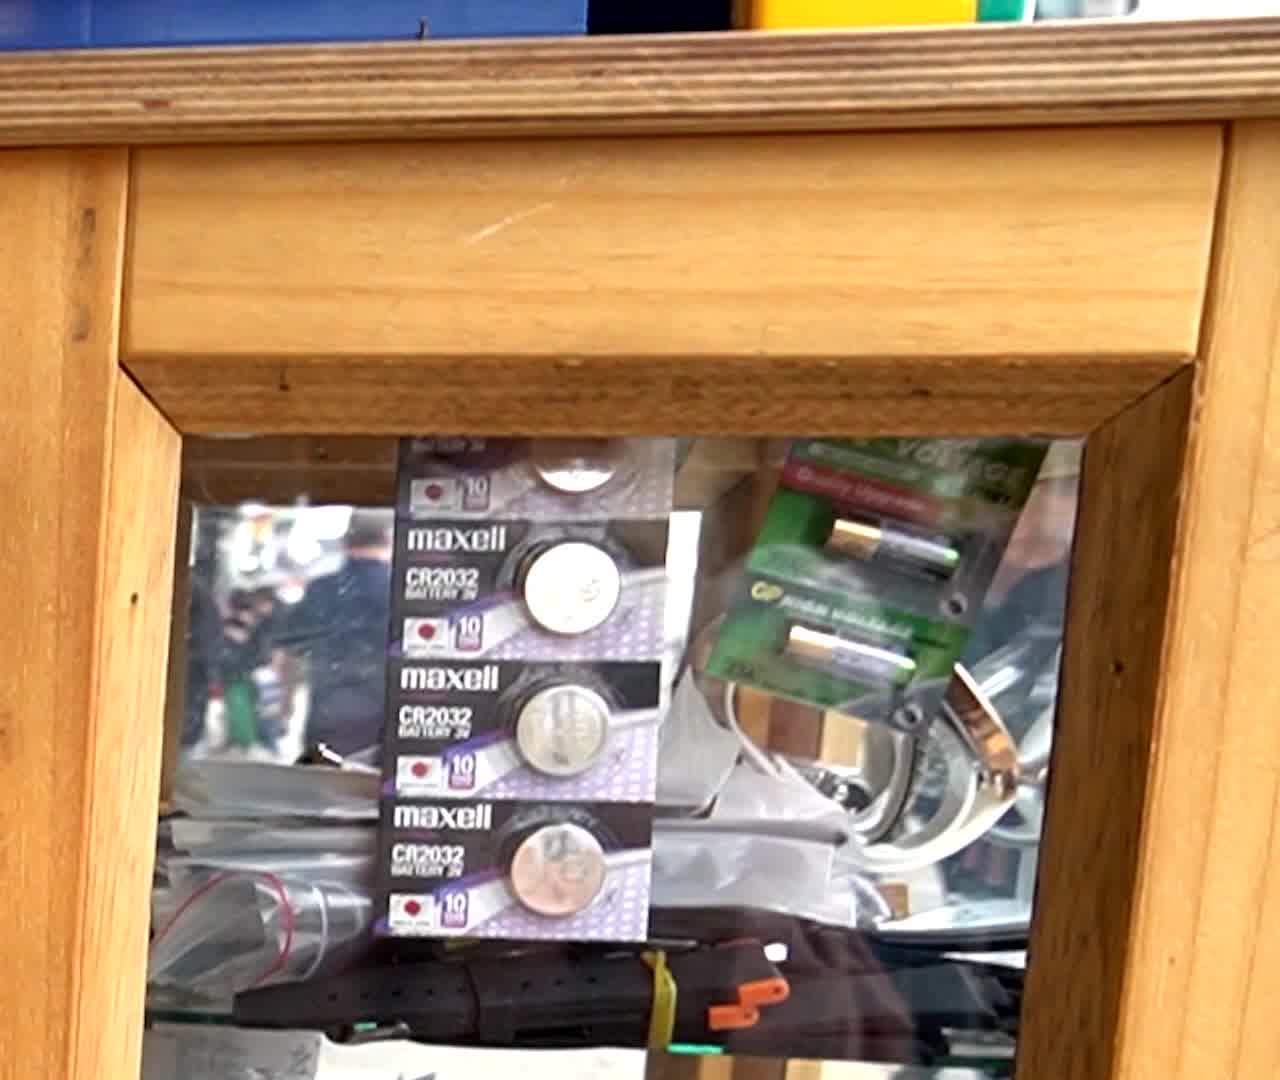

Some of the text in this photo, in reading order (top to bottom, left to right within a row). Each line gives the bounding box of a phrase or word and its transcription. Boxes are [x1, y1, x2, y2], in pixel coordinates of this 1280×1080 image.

[466, 478, 488, 496] 10
[407, 525, 507, 551] maxell
[406, 567, 479, 586] CR2032
[405, 585, 457, 600] BATTERY
[459, 615, 481, 634] 10
[400, 665, 500, 691] maxell
[399, 705, 473, 725] CR2032
[398, 723, 451, 738] BATTERY
[452, 754, 474, 773] 10
[394, 803, 492, 829] maxell
[392, 844, 465, 864] CR2032
[391, 862, 443, 877] BATTERY
[445, 893, 467, 912] 10
